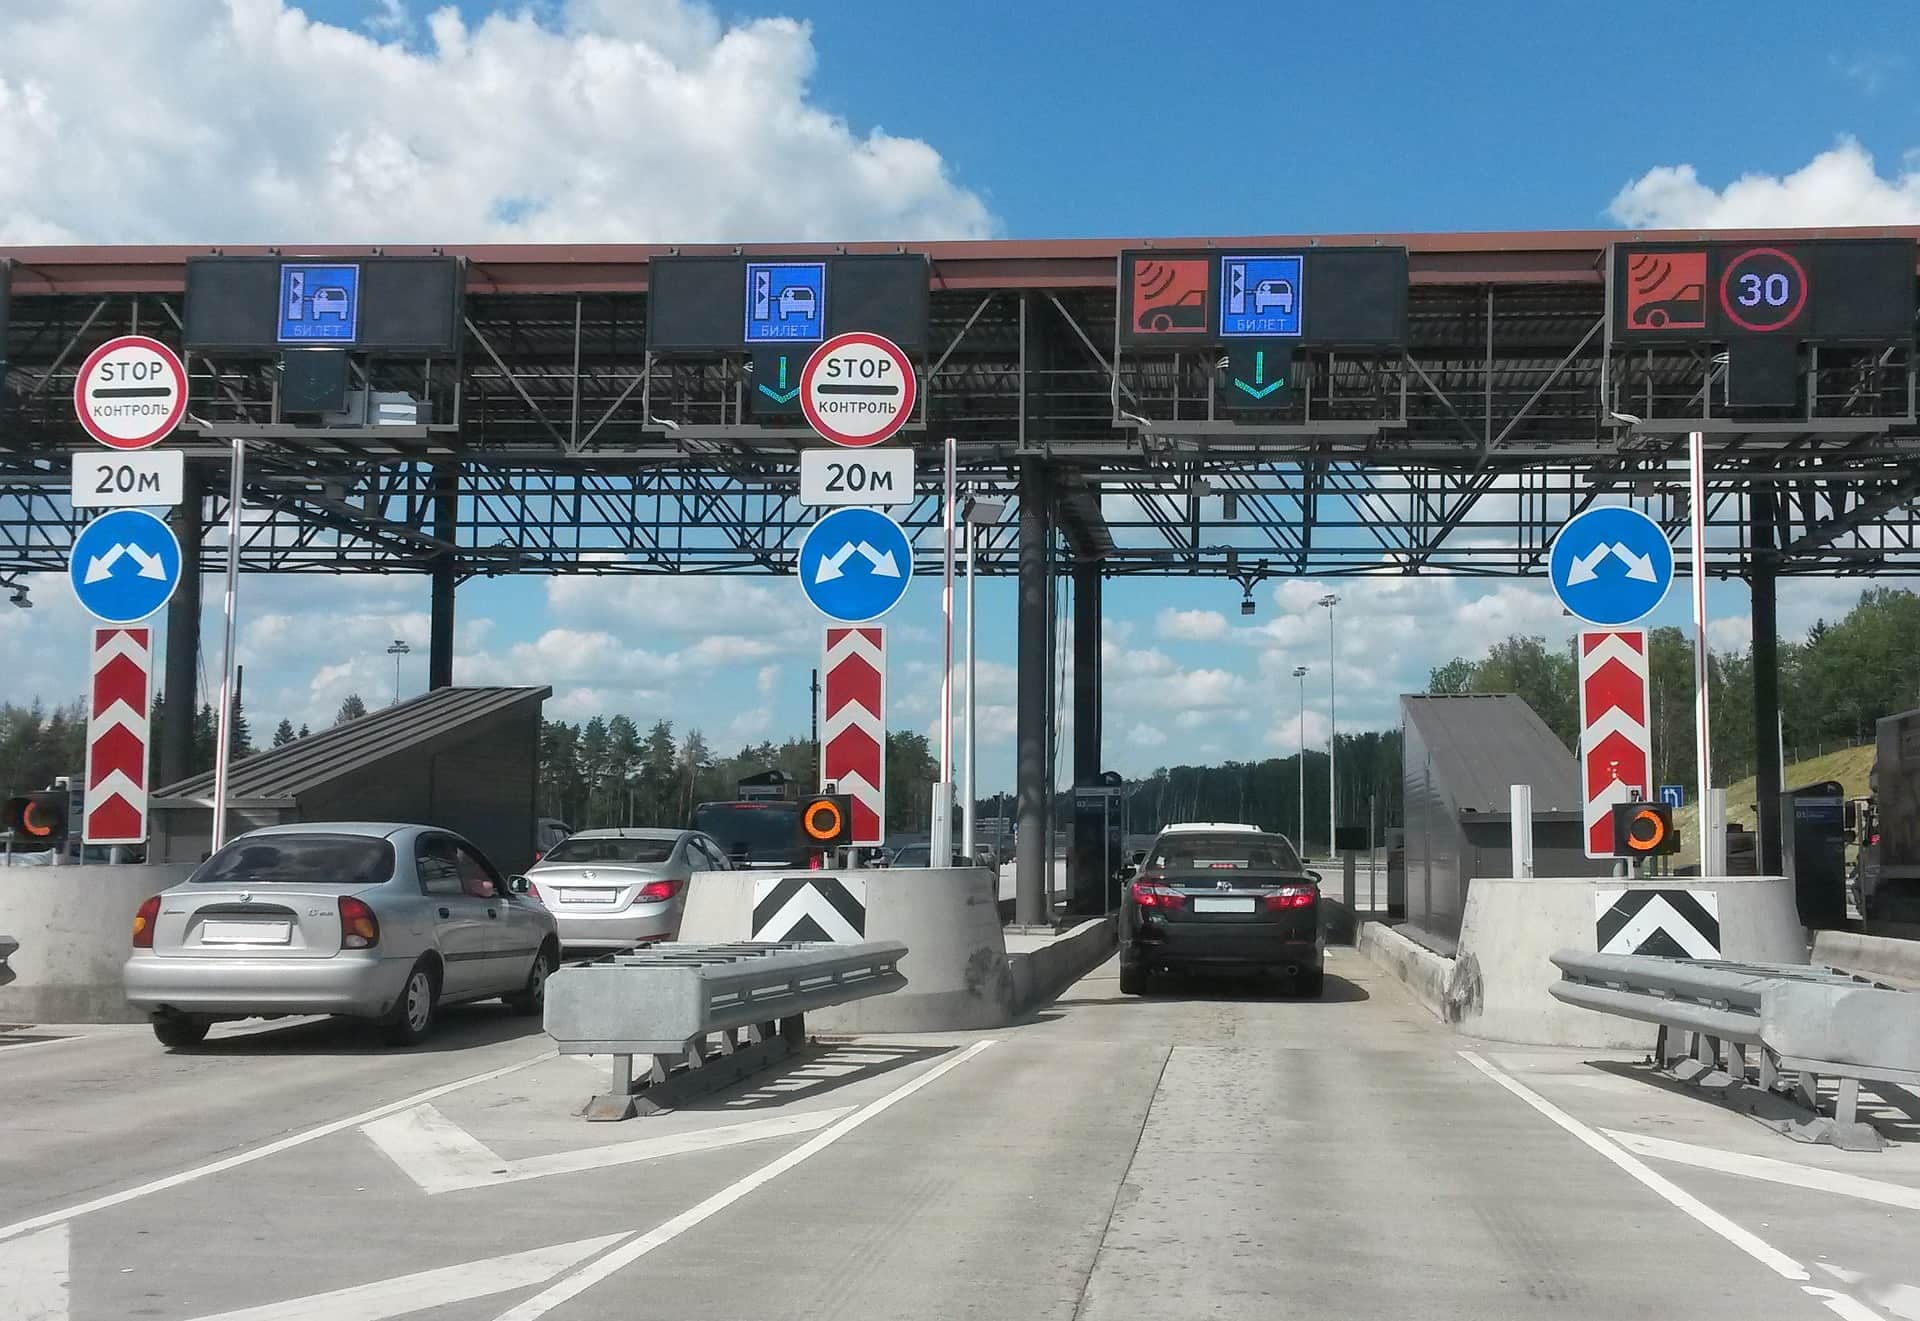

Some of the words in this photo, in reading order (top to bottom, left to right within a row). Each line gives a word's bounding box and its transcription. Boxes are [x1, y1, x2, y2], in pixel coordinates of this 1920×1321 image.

[1738, 273, 1789, 307] 30
[293, 324, 344, 337] БИЛЕТ
[761, 324, 809, 337] БИЛЕТ
[1237, 319, 1287, 331] БИЛЕТ
[100, 361, 163, 381] STOP
[826, 358, 891, 379] STOP
[93, 403, 170, 417] КОНТРОЛЬ
[819, 401, 897, 414] КОНТРОЛЬ
